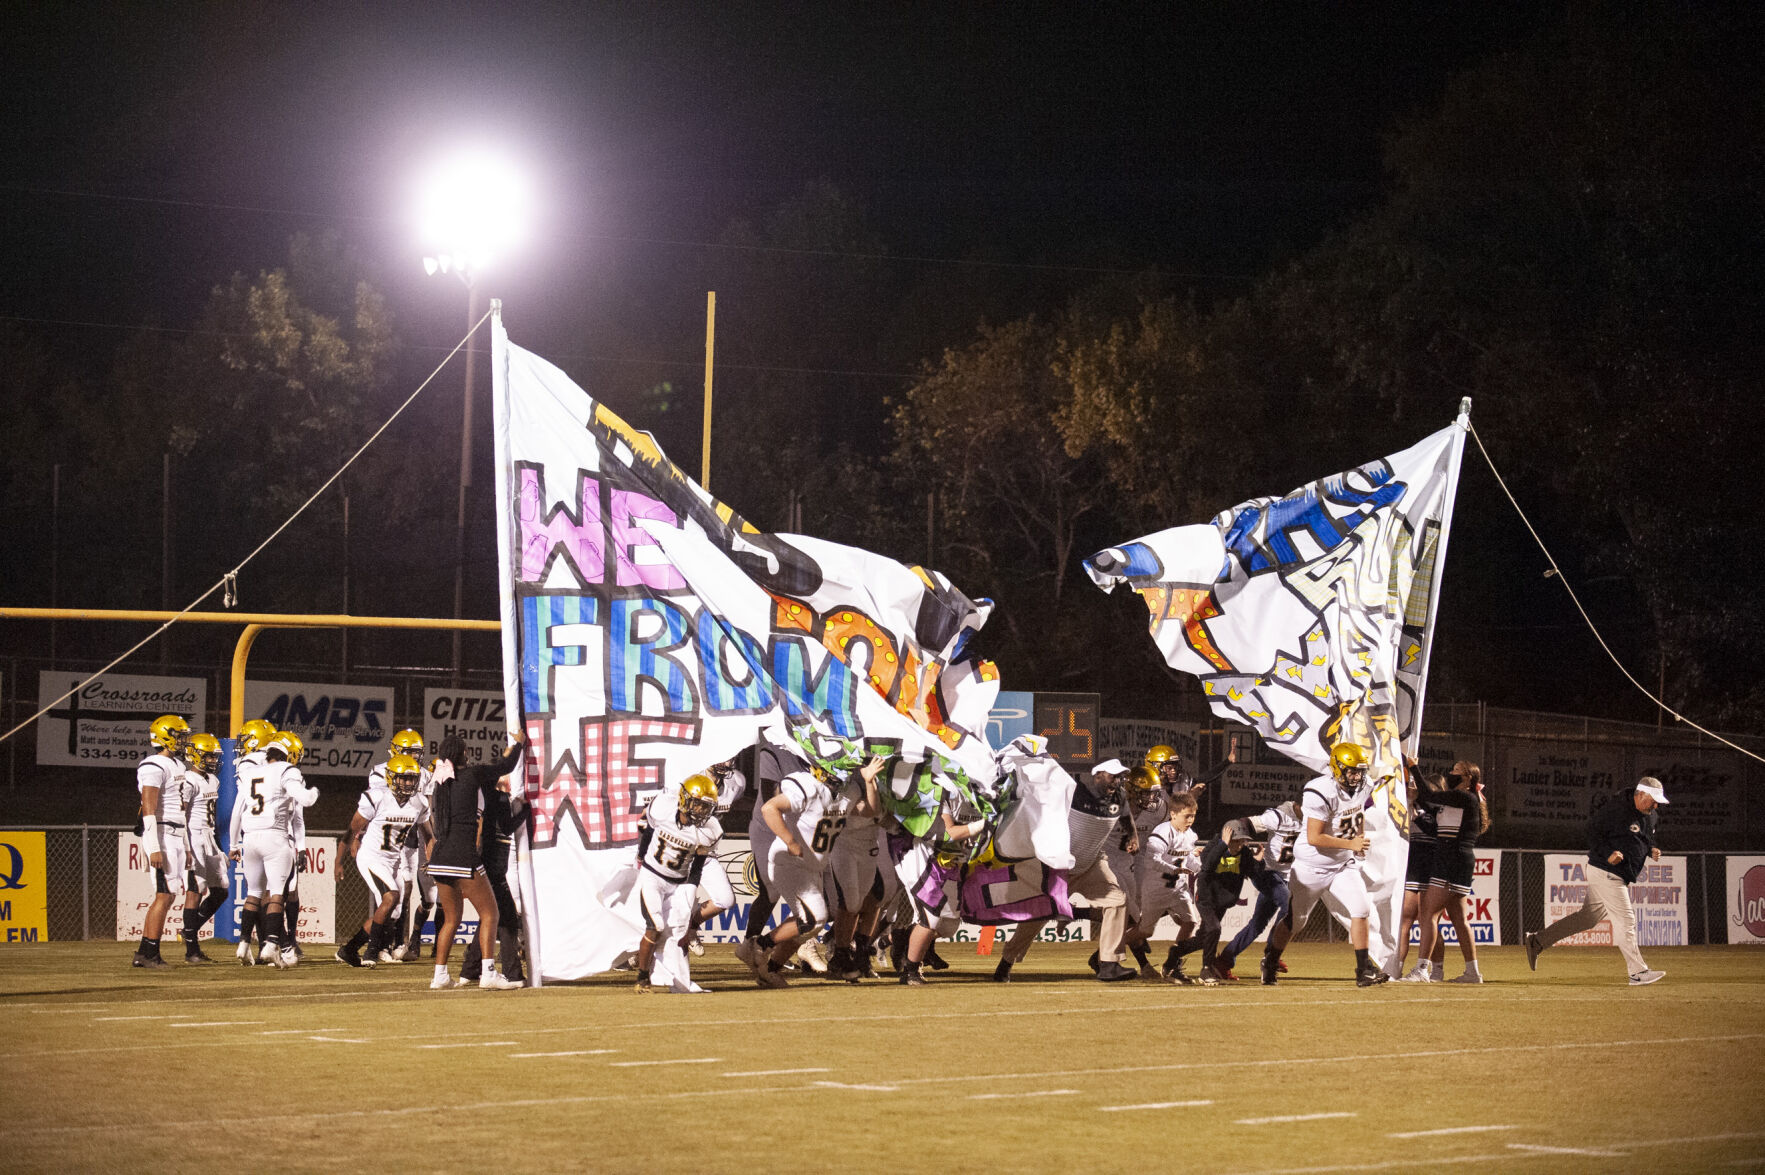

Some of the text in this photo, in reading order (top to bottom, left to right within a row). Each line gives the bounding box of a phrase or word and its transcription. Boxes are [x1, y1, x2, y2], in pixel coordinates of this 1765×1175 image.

[514, 459, 694, 597] WE
[516, 592, 865, 742] FROM
[82, 682, 198, 703] Crossroads
[85, 701, 193, 712] LEARNING CENTER
[431, 696, 505, 722] CITIZ
[262, 694, 387, 743] AMPS
[81, 735, 96, 744] Matt
[97, 735, 110, 744] and
[112, 736, 138, 746] Hannah
[311, 723, 325, 734] and
[328, 723, 353, 738] Pump
[354, 725, 386, 739] Service
[444, 724, 508, 742] Hardw
[1039, 706, 1093, 759] 25
[520, 714, 703, 850] WE
[1230, 780, 1281, 792] TALLASSEE
[1249, 771, 1304, 782] FRIENDSHIP
[1512, 767, 1550, 785] Lanier
[1553, 770, 1587, 788] Baker
[250, 777, 264, 816] 5
[653, 836, 690, 871] 13
[1550, 884, 1589, 904] POWE
[1627, 885, 1682, 905] UIPMENT
[1441, 926, 1492, 941] COTY
